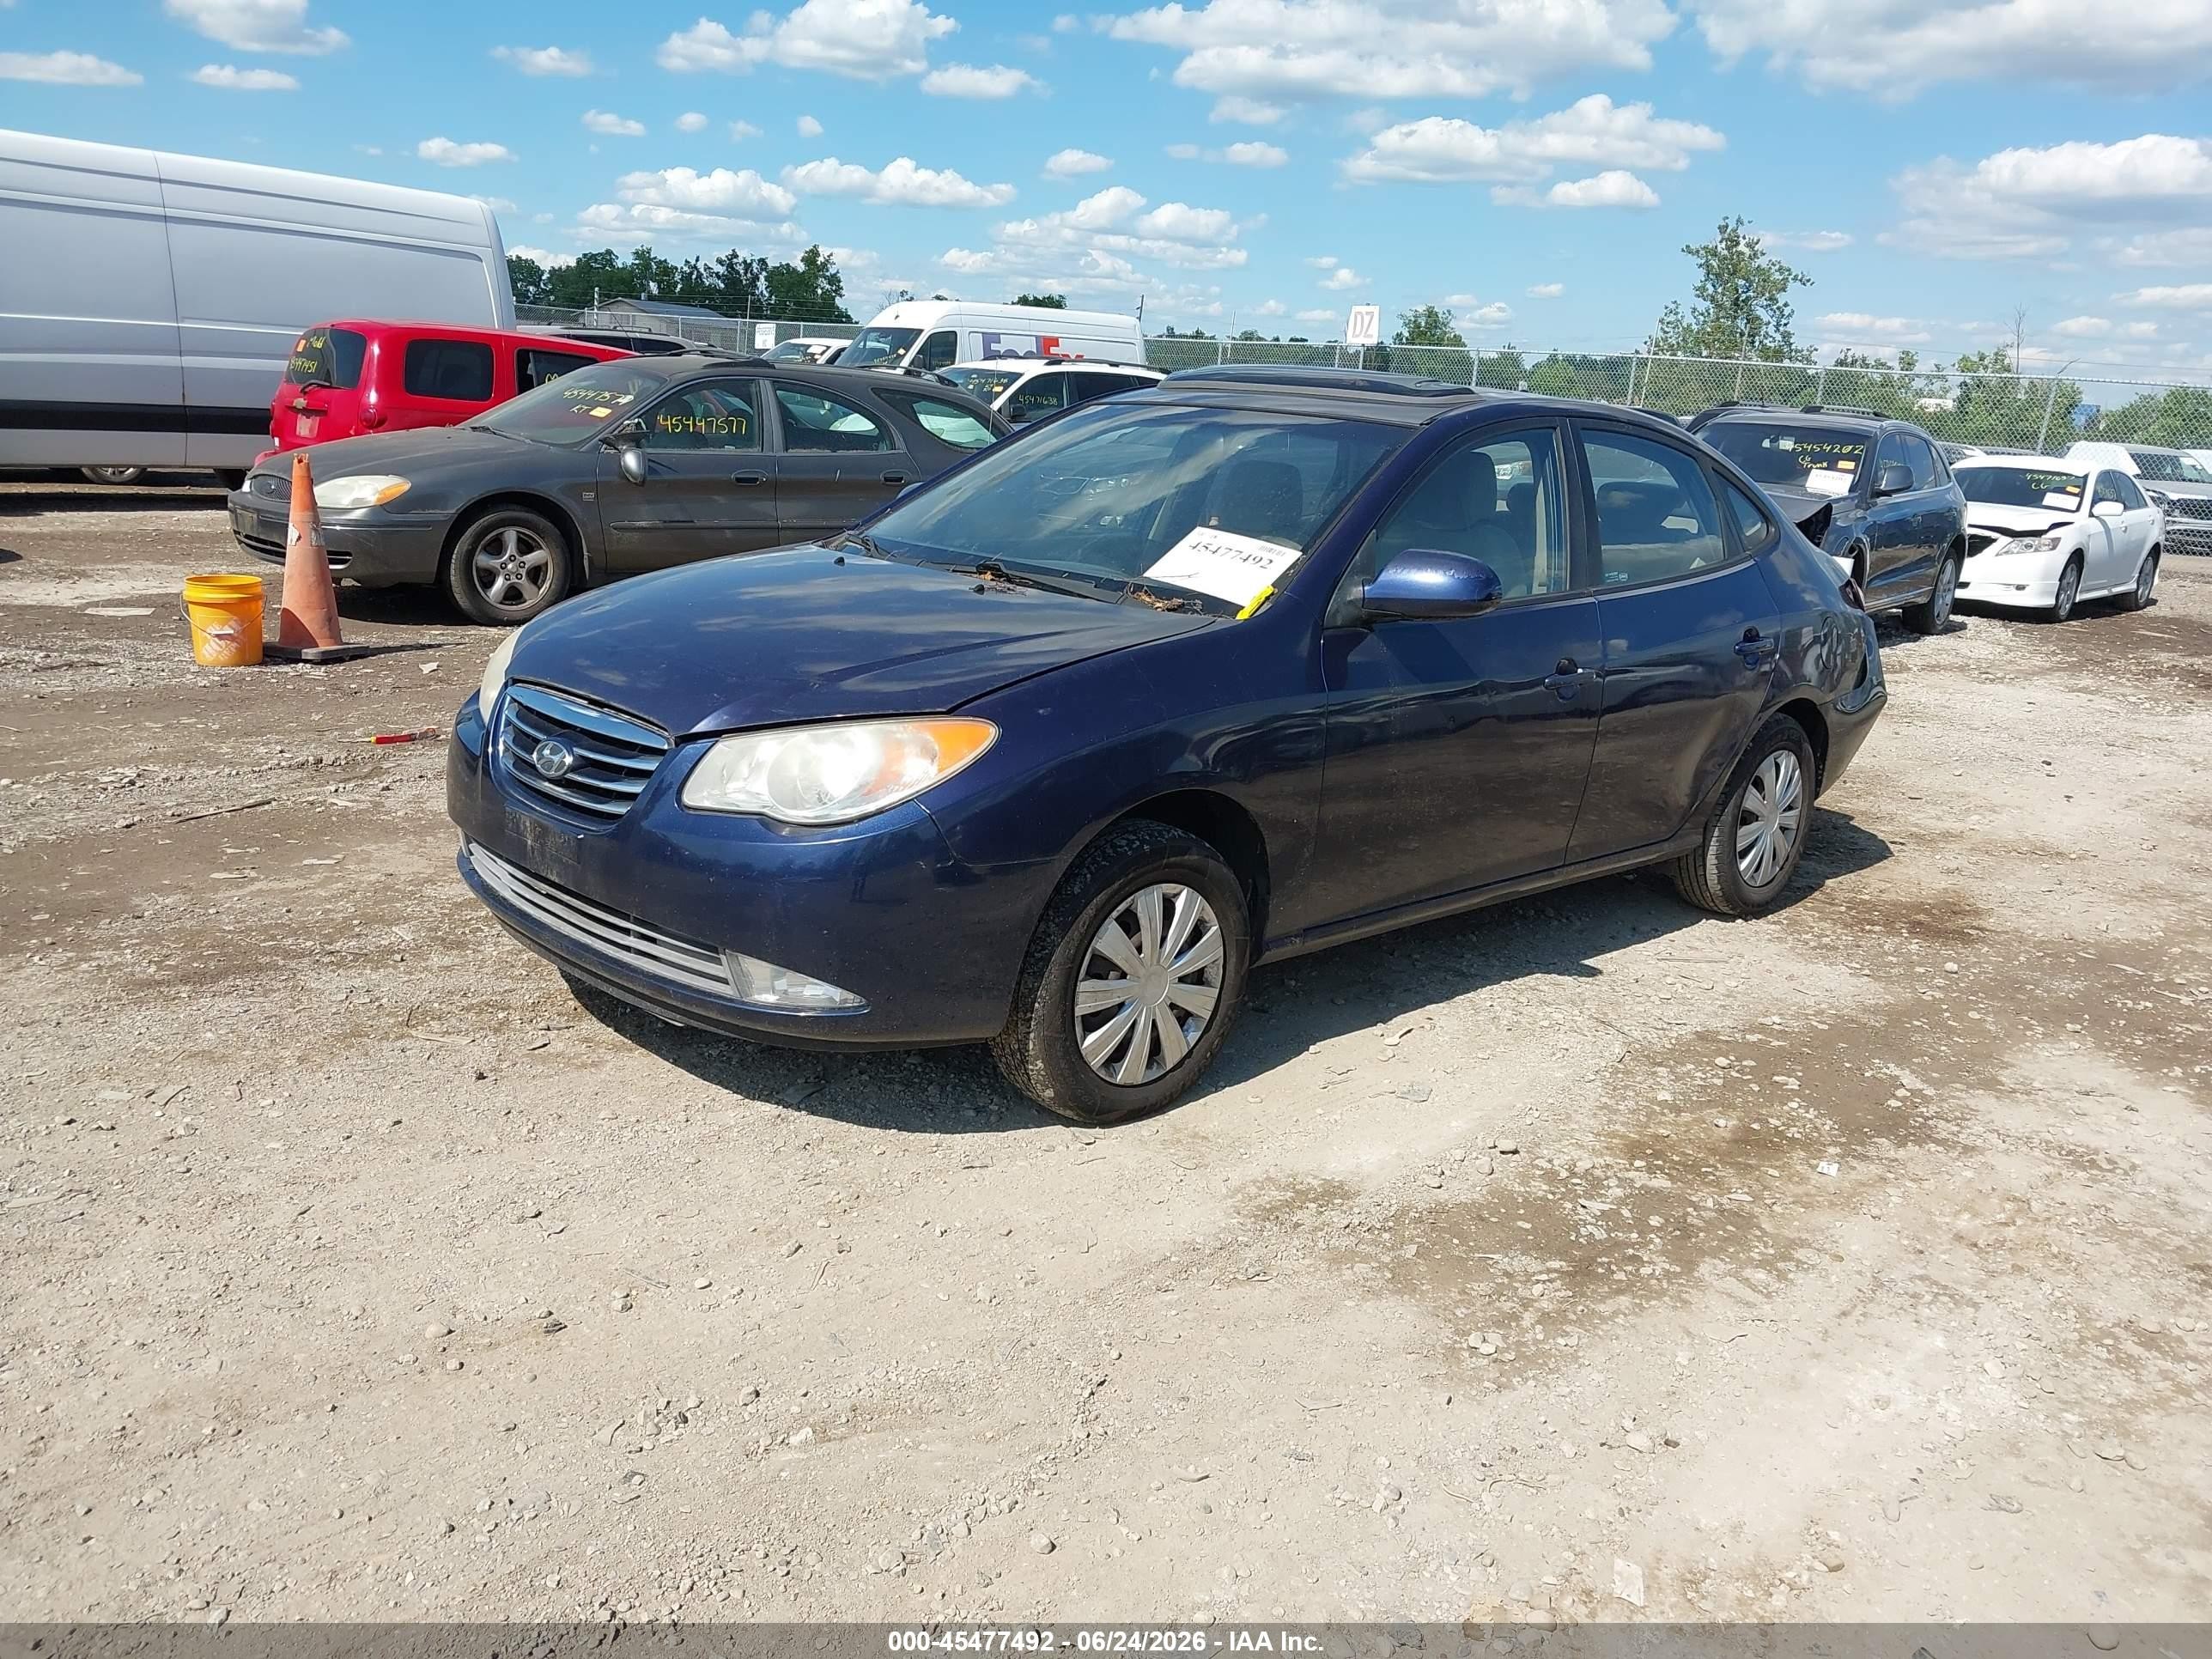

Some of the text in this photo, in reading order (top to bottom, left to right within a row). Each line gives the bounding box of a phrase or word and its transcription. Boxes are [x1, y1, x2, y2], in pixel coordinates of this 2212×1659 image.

[1018, 394, 1058, 405] 45471638
[658, 414, 746, 434] 45447577
[1786, 442, 1864, 455] 45454202
[1188, 541, 1273, 569] 45477492
